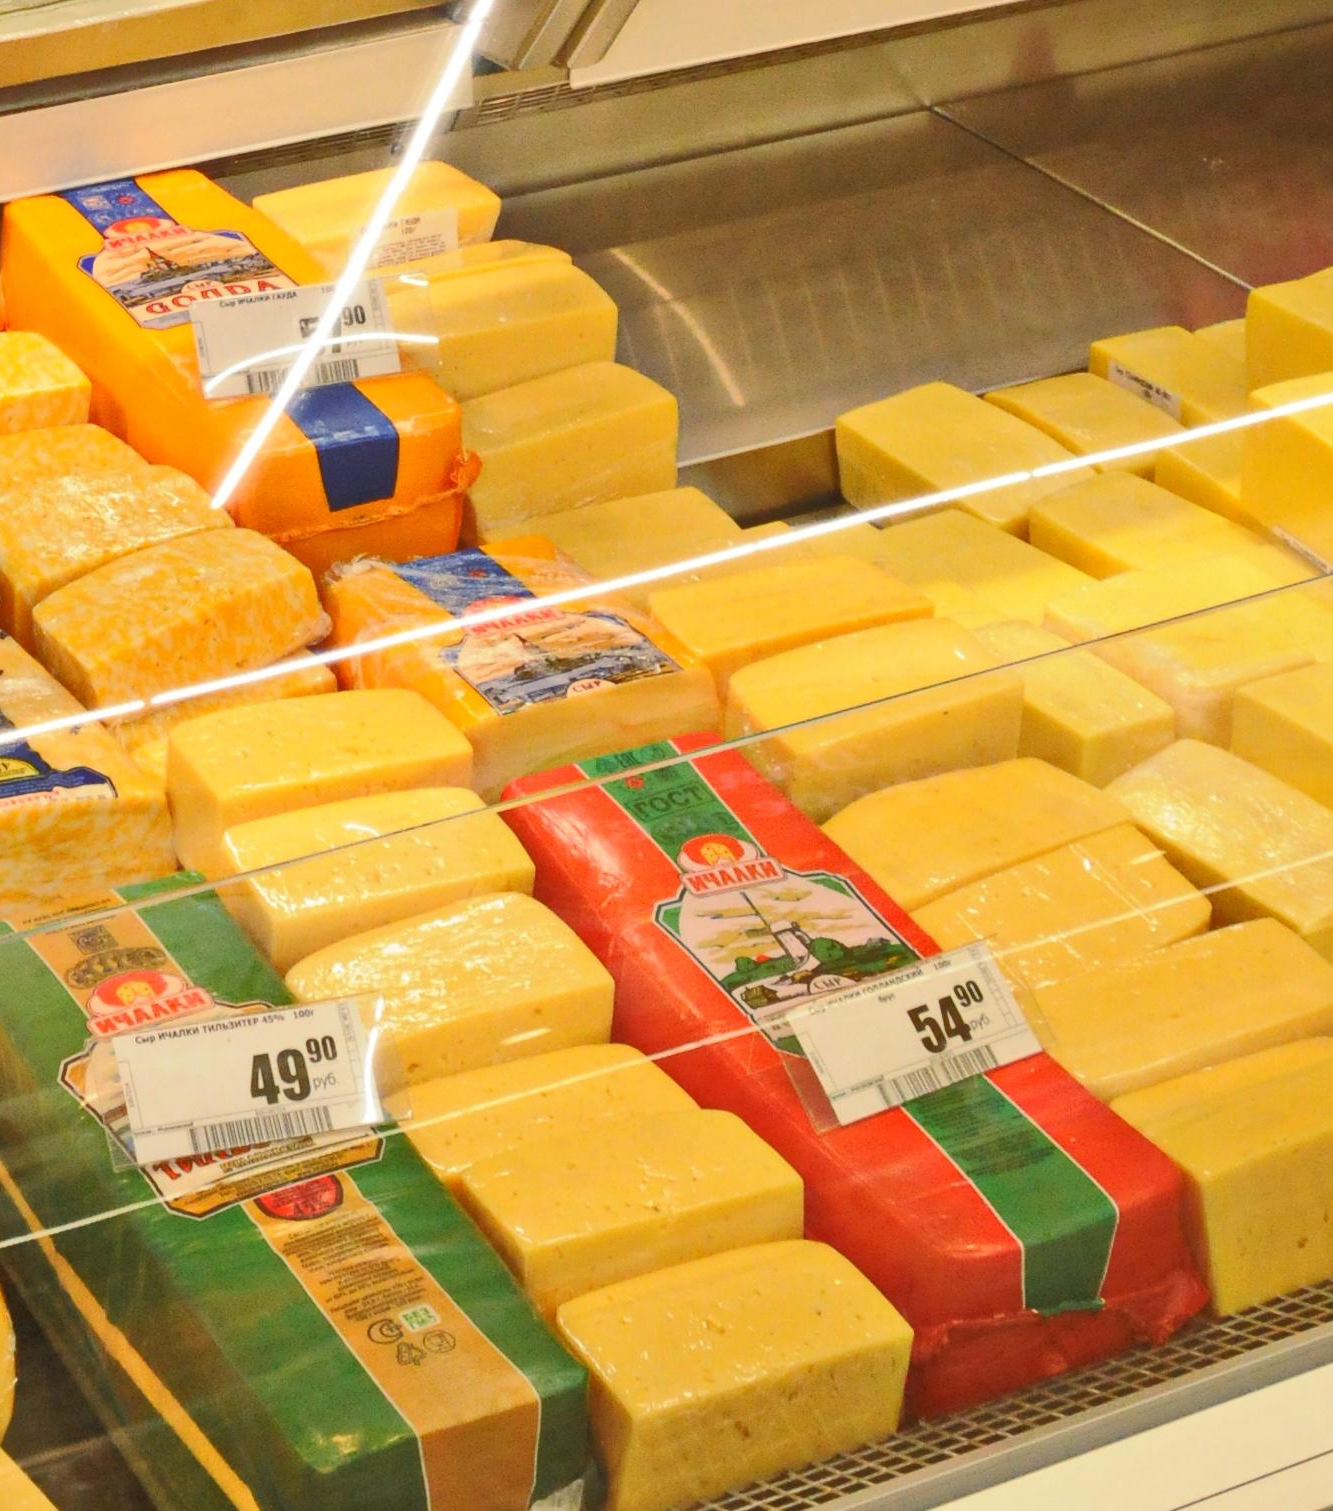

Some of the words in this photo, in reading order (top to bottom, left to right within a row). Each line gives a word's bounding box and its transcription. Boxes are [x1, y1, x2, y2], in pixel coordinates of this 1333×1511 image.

[272, 291, 297, 302] ГАУДА
[343, 304, 366, 326] 90
[632, 786, 703, 818] ГОСТ
[687, 860, 779, 893] ИЧАЛКИ
[95, 989, 205, 1034] ИЧАЛКИ
[135, 1034, 156, 1045] Сыр
[158, 1026, 200, 1042] ИЧАЛКИ
[202, 1017, 259, 1035] ТИЛЬЗИТЕР
[261, 1013, 285, 1025] 45%
[293, 1009, 315, 1020] 100г
[907, 996, 972, 1053] 54
[954, 980, 984, 1008] 90
[250, 1048, 311, 1105] 49
[305, 1035, 338, 1063] 90
